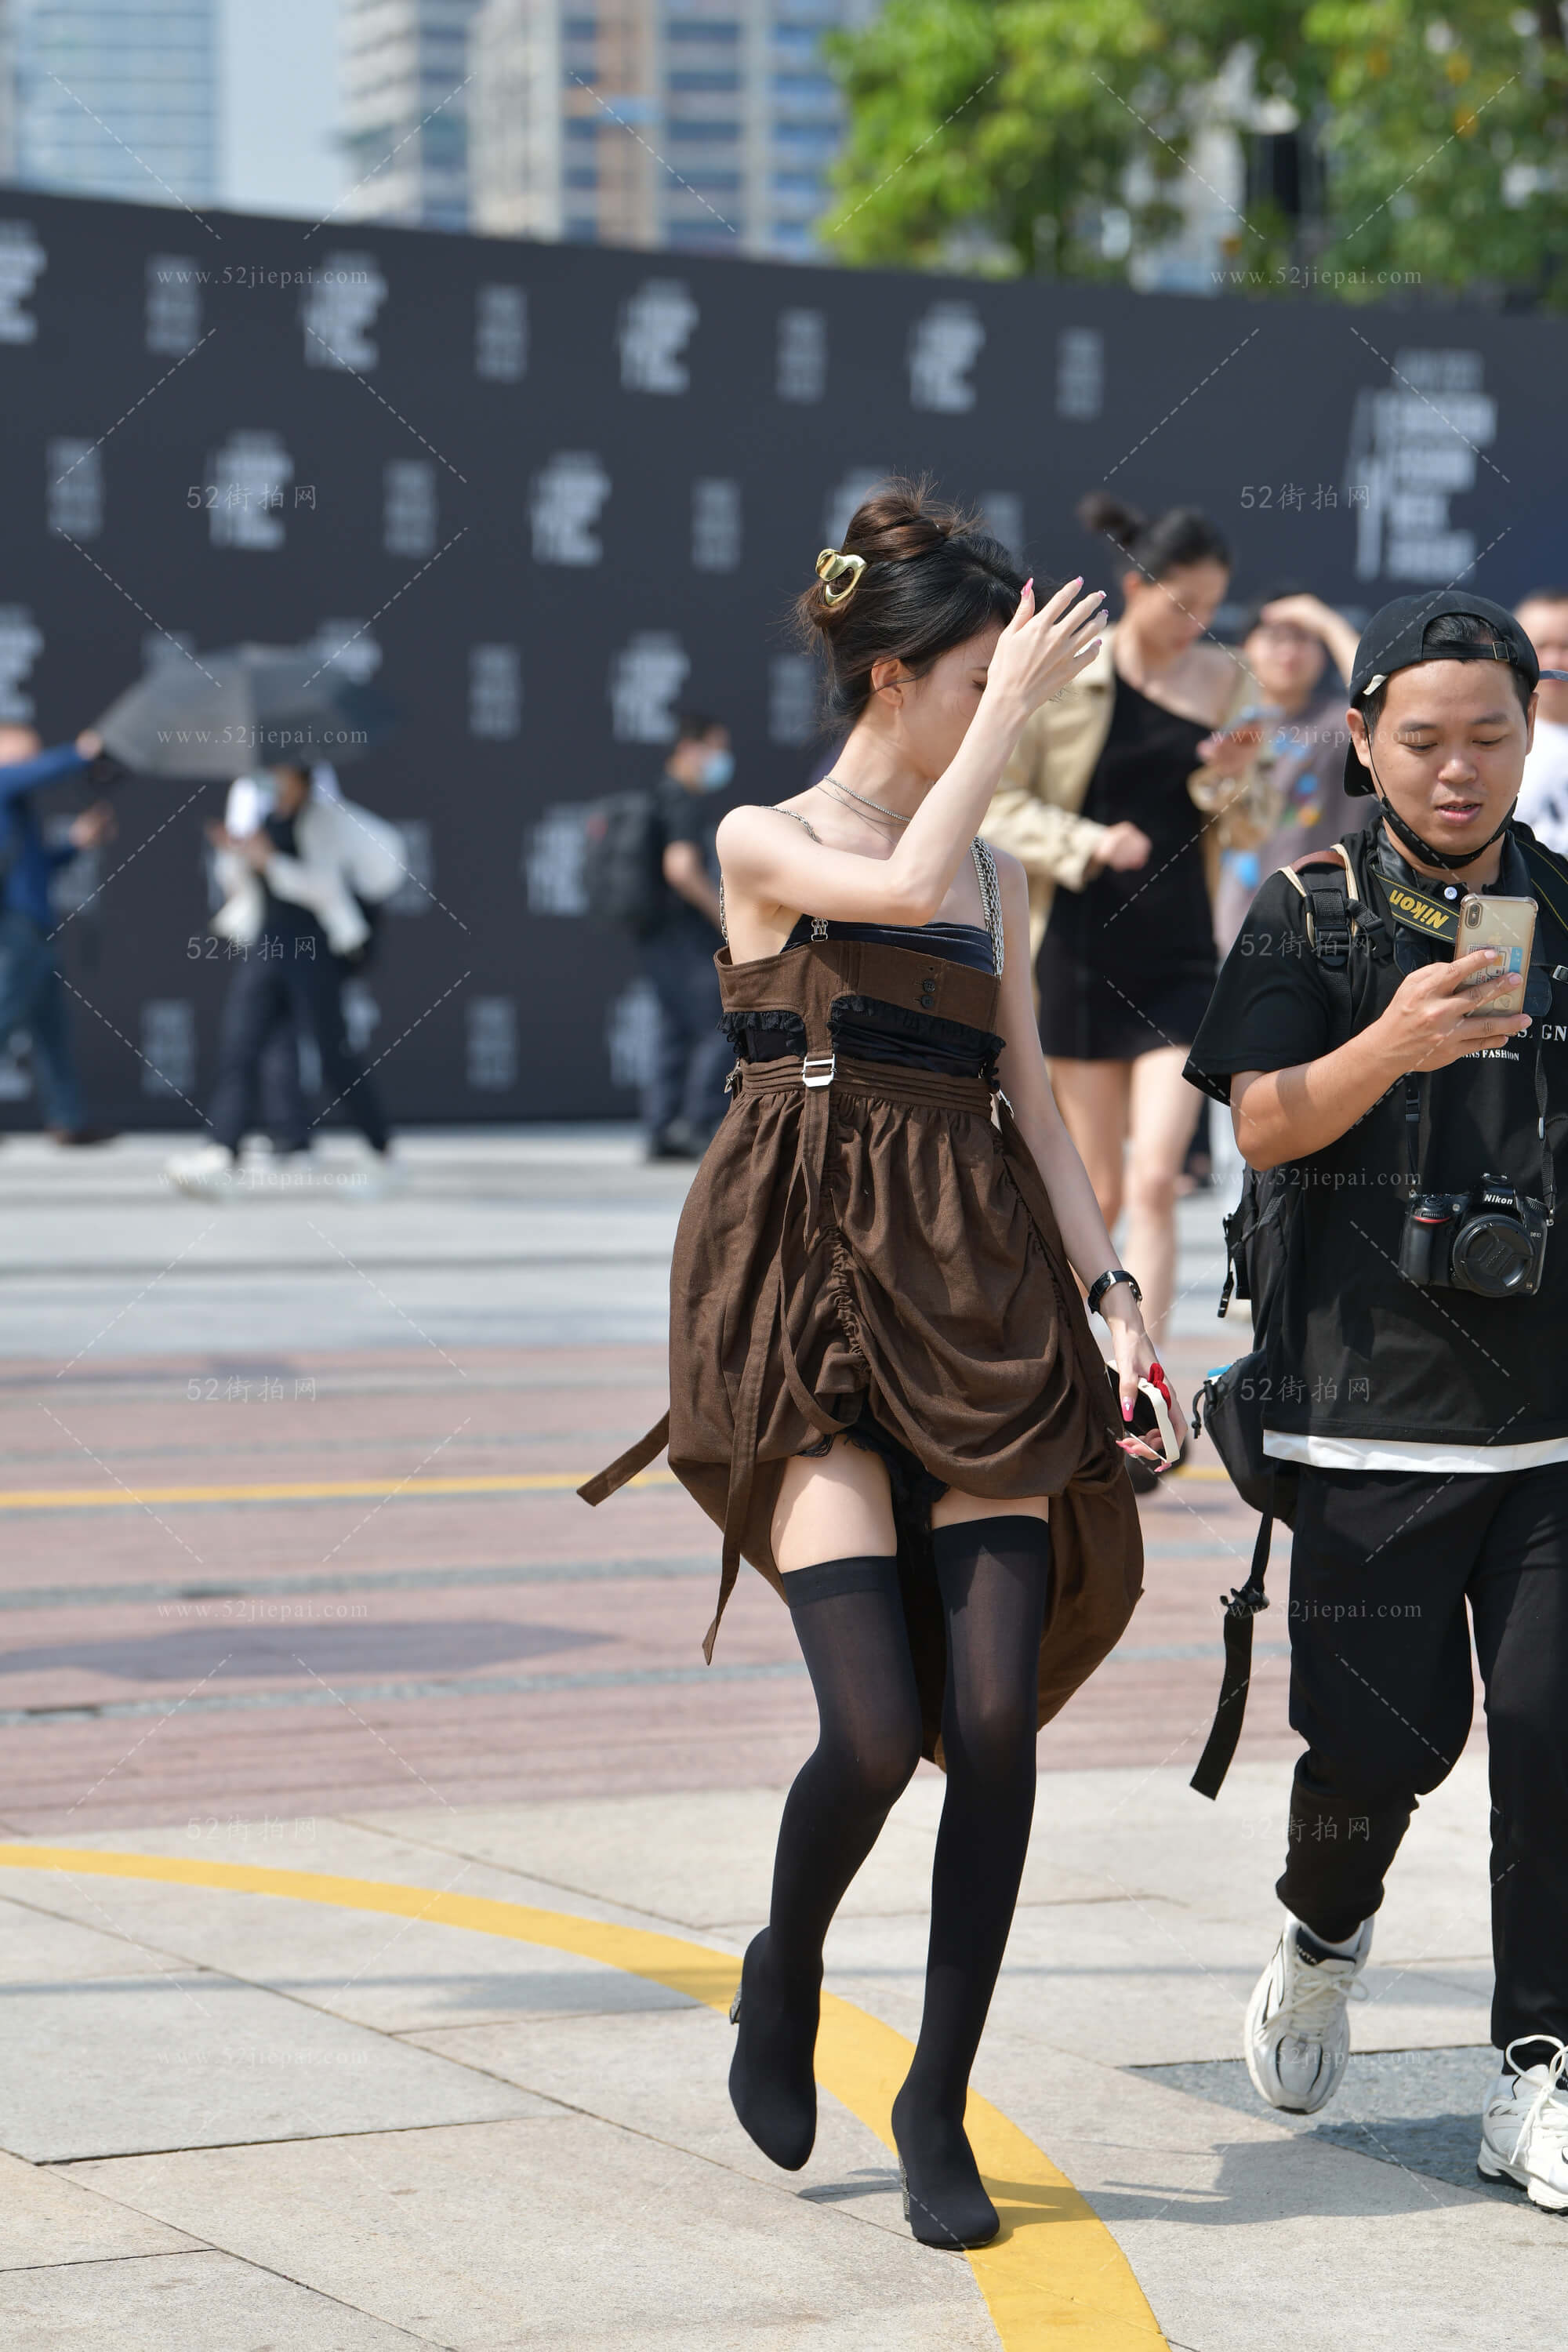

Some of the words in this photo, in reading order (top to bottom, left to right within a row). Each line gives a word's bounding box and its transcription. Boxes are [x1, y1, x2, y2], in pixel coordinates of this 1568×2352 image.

[1388, 889, 1449, 929] Nikon
[1482, 1049, 1519, 1062] FASHION
[1483, 1193, 1513, 1205] Nikon
